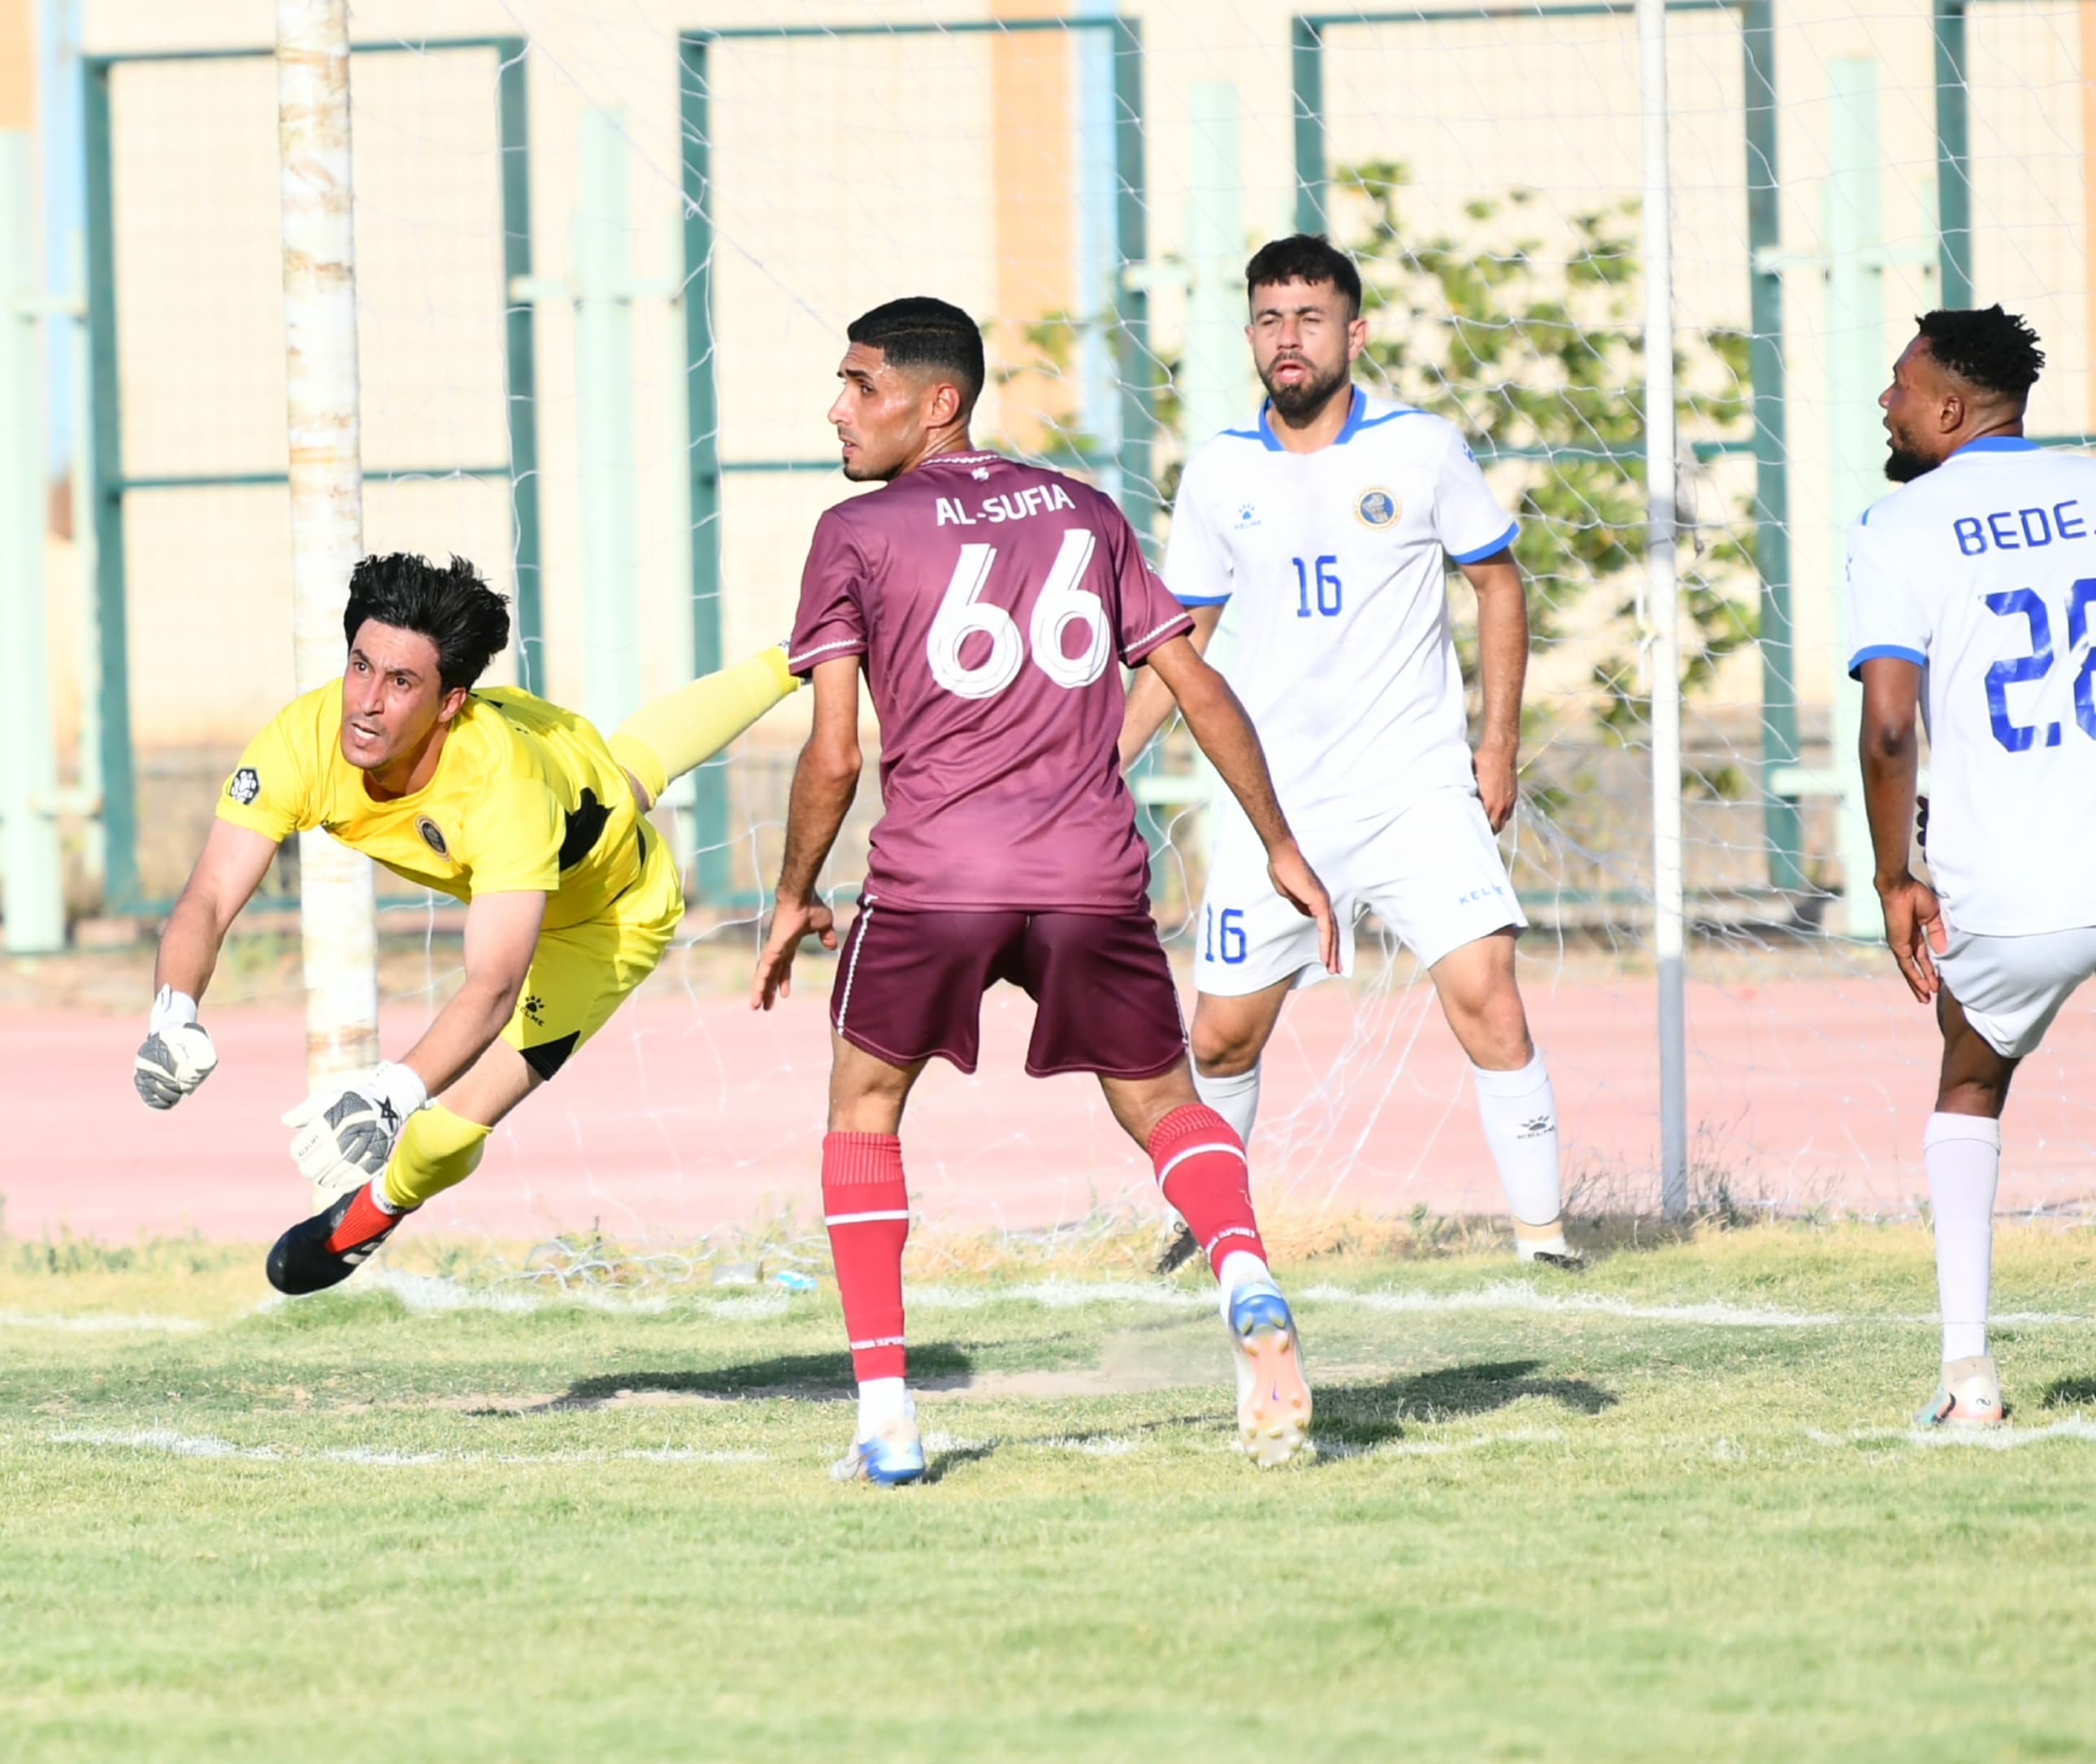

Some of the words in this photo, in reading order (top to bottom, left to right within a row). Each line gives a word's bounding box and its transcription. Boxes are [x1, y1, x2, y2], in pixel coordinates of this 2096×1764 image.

[935, 483, 1077, 527] AL-SUFIA
[1953, 499, 2096, 557] BEDE
[926, 528, 1111, 700] 66
[1291, 555, 1342, 617] 16
[1204, 902, 1247, 964] 16
